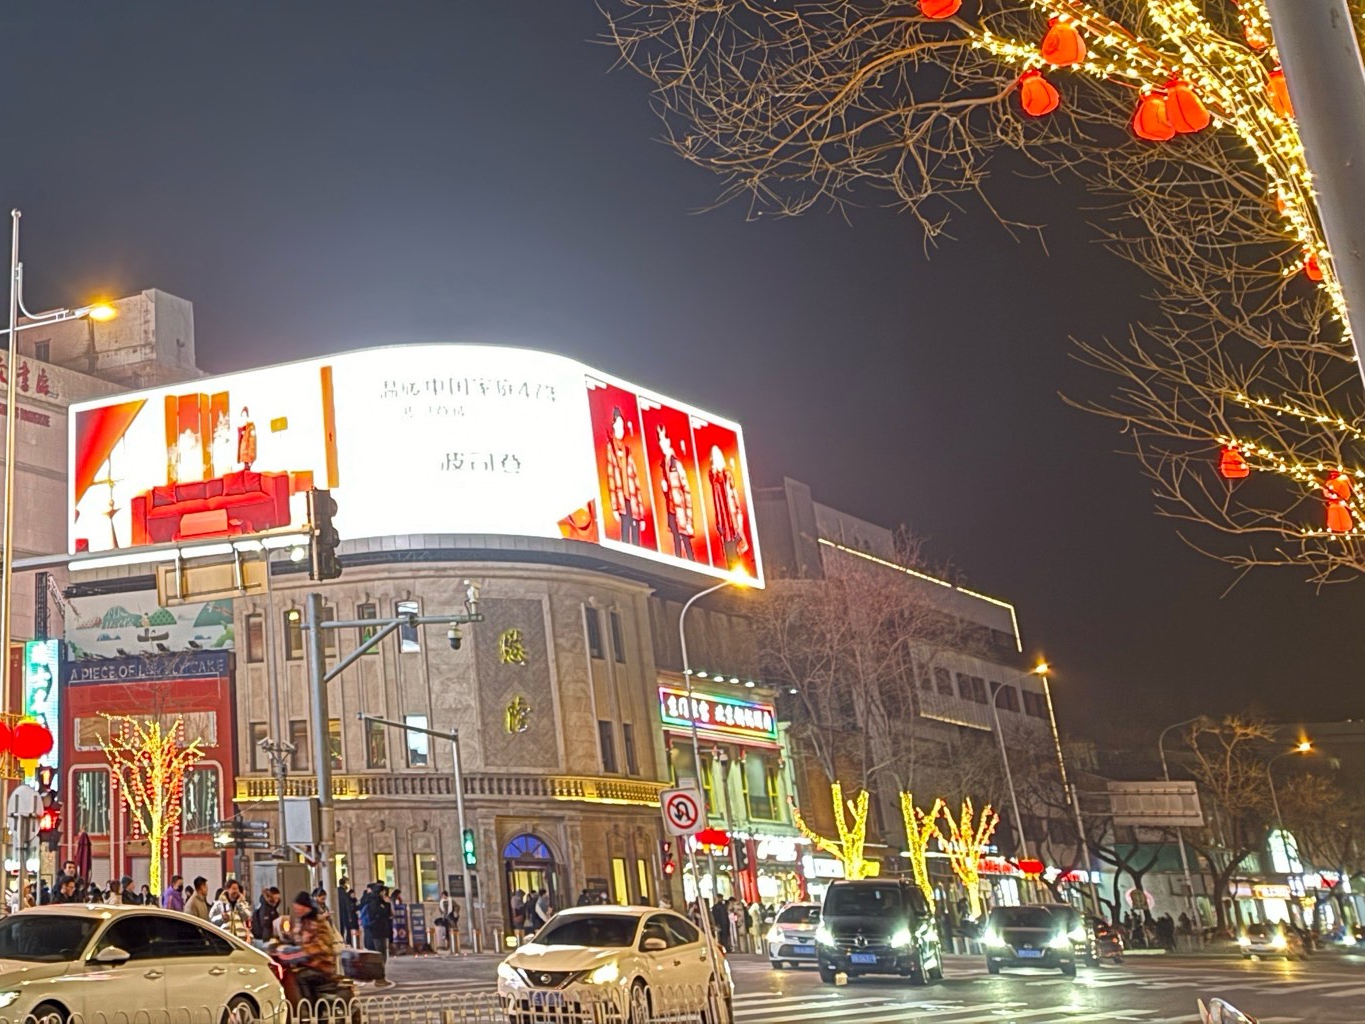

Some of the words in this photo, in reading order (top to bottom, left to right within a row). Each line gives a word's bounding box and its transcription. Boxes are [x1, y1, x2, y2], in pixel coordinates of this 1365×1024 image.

[70, 669, 78, 680] A
[81, 665, 115, 680] PIECE
[118, 665, 135, 677] OF
[192, 659, 224, 673] CAKE
